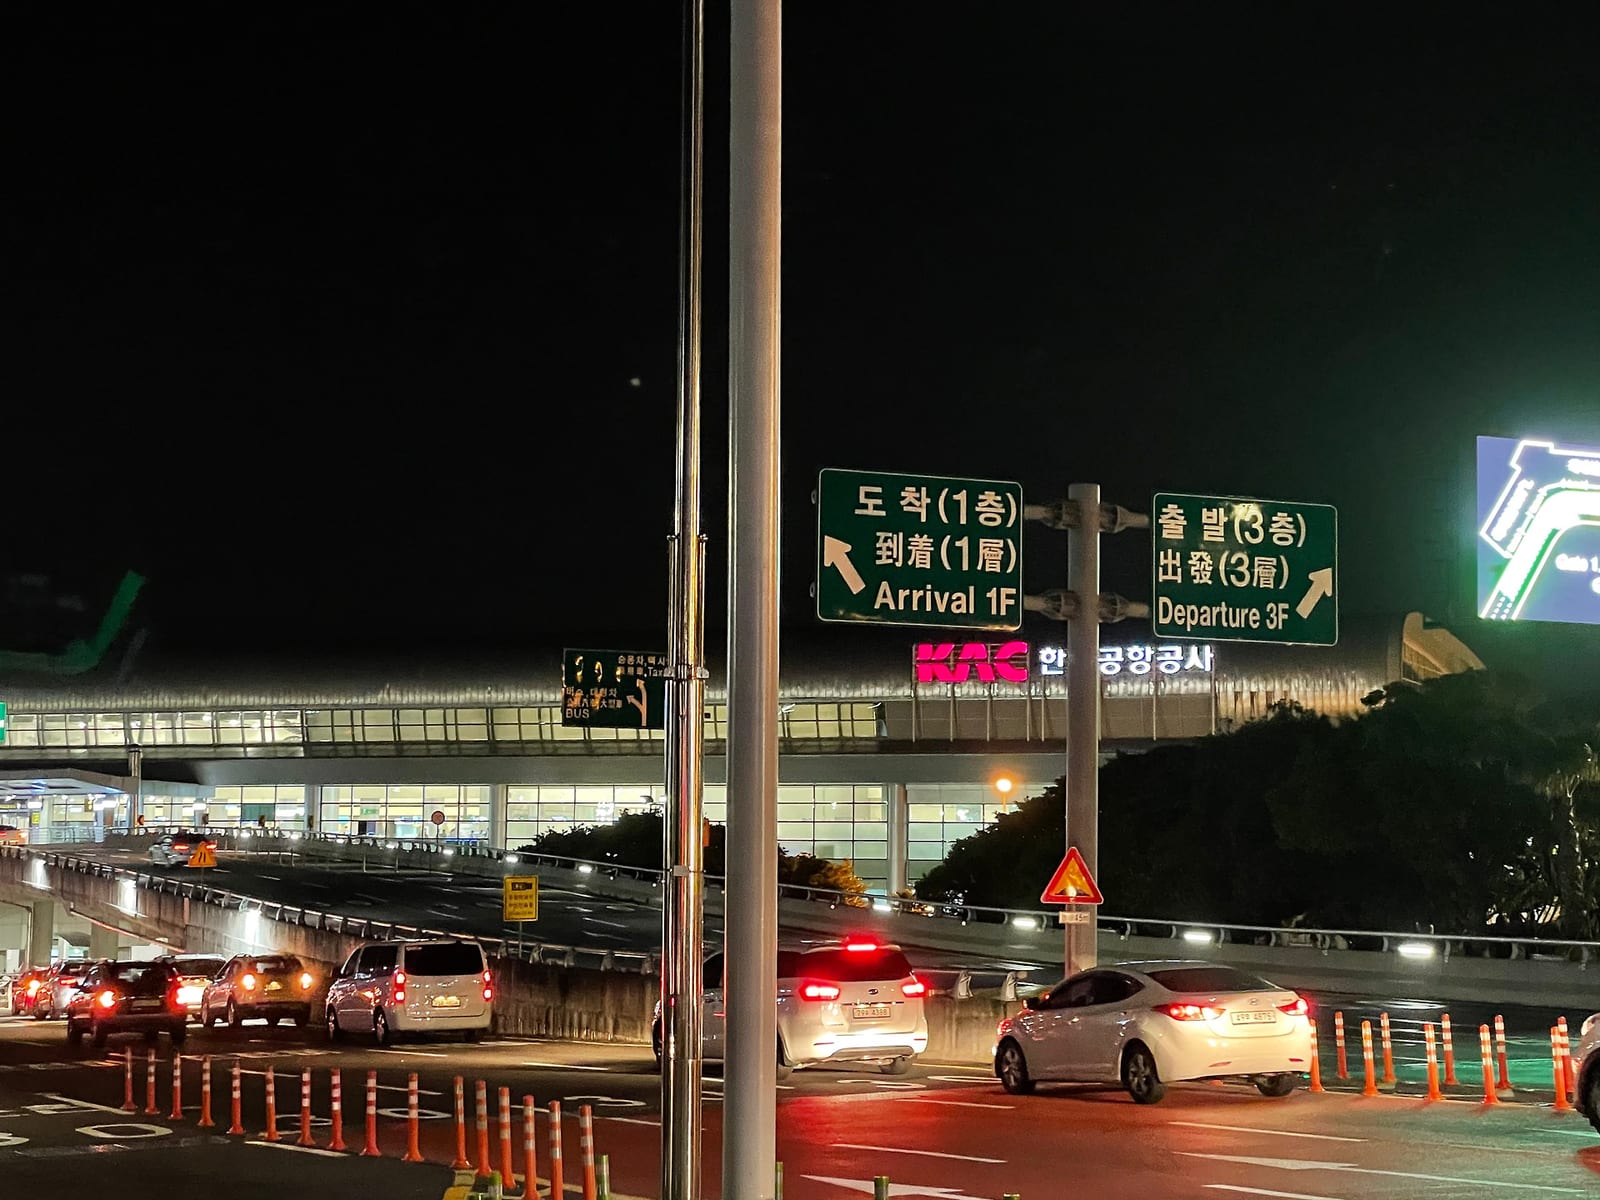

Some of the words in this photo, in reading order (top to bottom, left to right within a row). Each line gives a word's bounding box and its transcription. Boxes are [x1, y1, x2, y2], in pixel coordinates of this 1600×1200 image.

[854, 485, 887, 517] 도
[900, 486, 1017, 528] 착(1층)
[1158, 503, 1188, 540] 출
[1201, 506, 1307, 548] 발(3층)
[875, 531, 1017, 574] 到着(1層)
[873, 580, 975, 615] Arrival
[985, 586, 1017, 616] 1F
[1158, 596, 1261, 632] Departure
[1265, 602, 1290, 630] 3F
[915, 640, 1029, 684] KAC
[1038, 645, 1215, 676] 한공항공사
[565, 708, 590, 719] BUS
